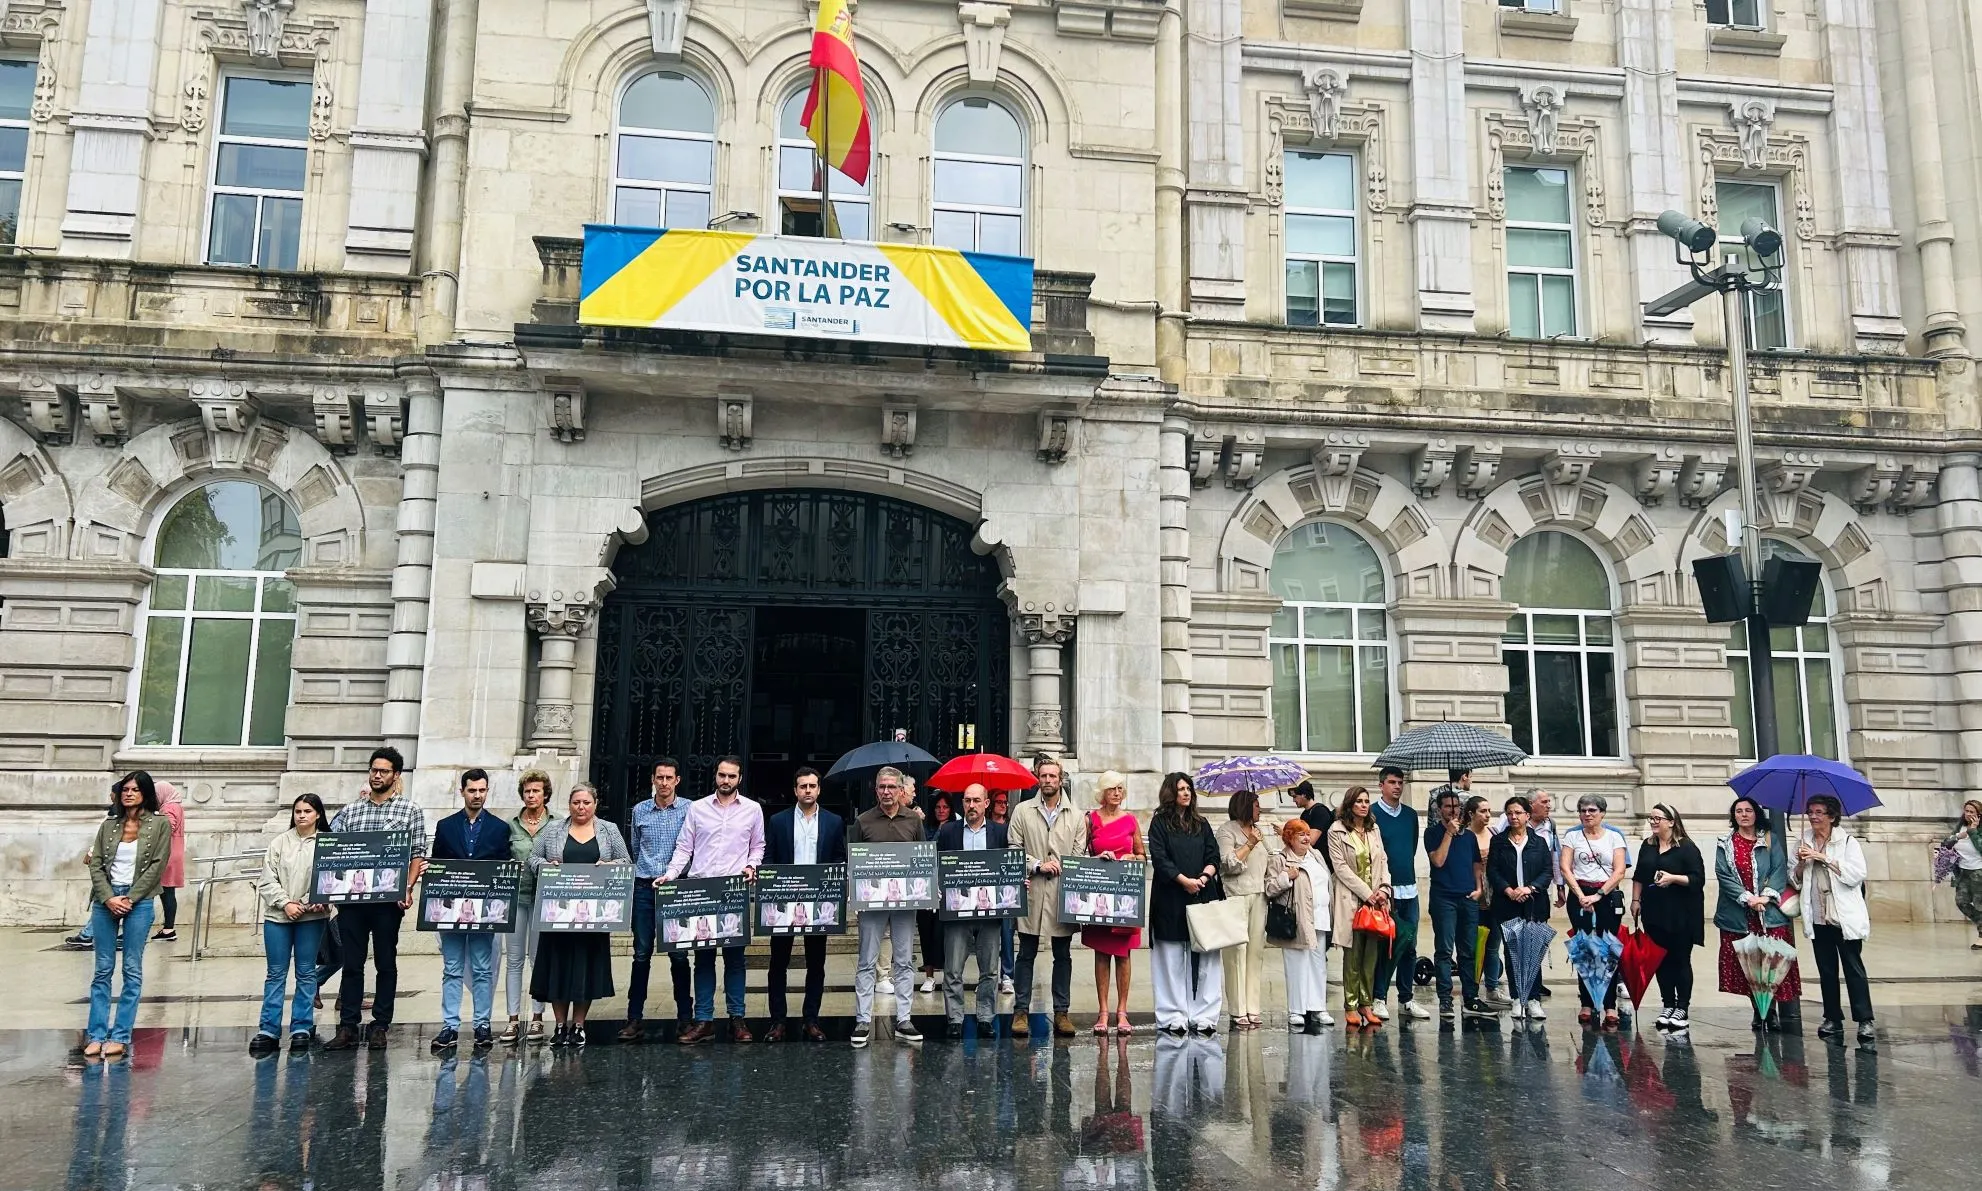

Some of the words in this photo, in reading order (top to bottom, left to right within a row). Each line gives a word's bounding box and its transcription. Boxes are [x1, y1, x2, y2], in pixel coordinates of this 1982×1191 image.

[736, 254, 890, 282] SANTANDER
[735, 277, 790, 302] POR
[798, 282, 831, 305] LA
[839, 285, 890, 309] PAZ
[801, 316, 849, 325] SANTANDER
